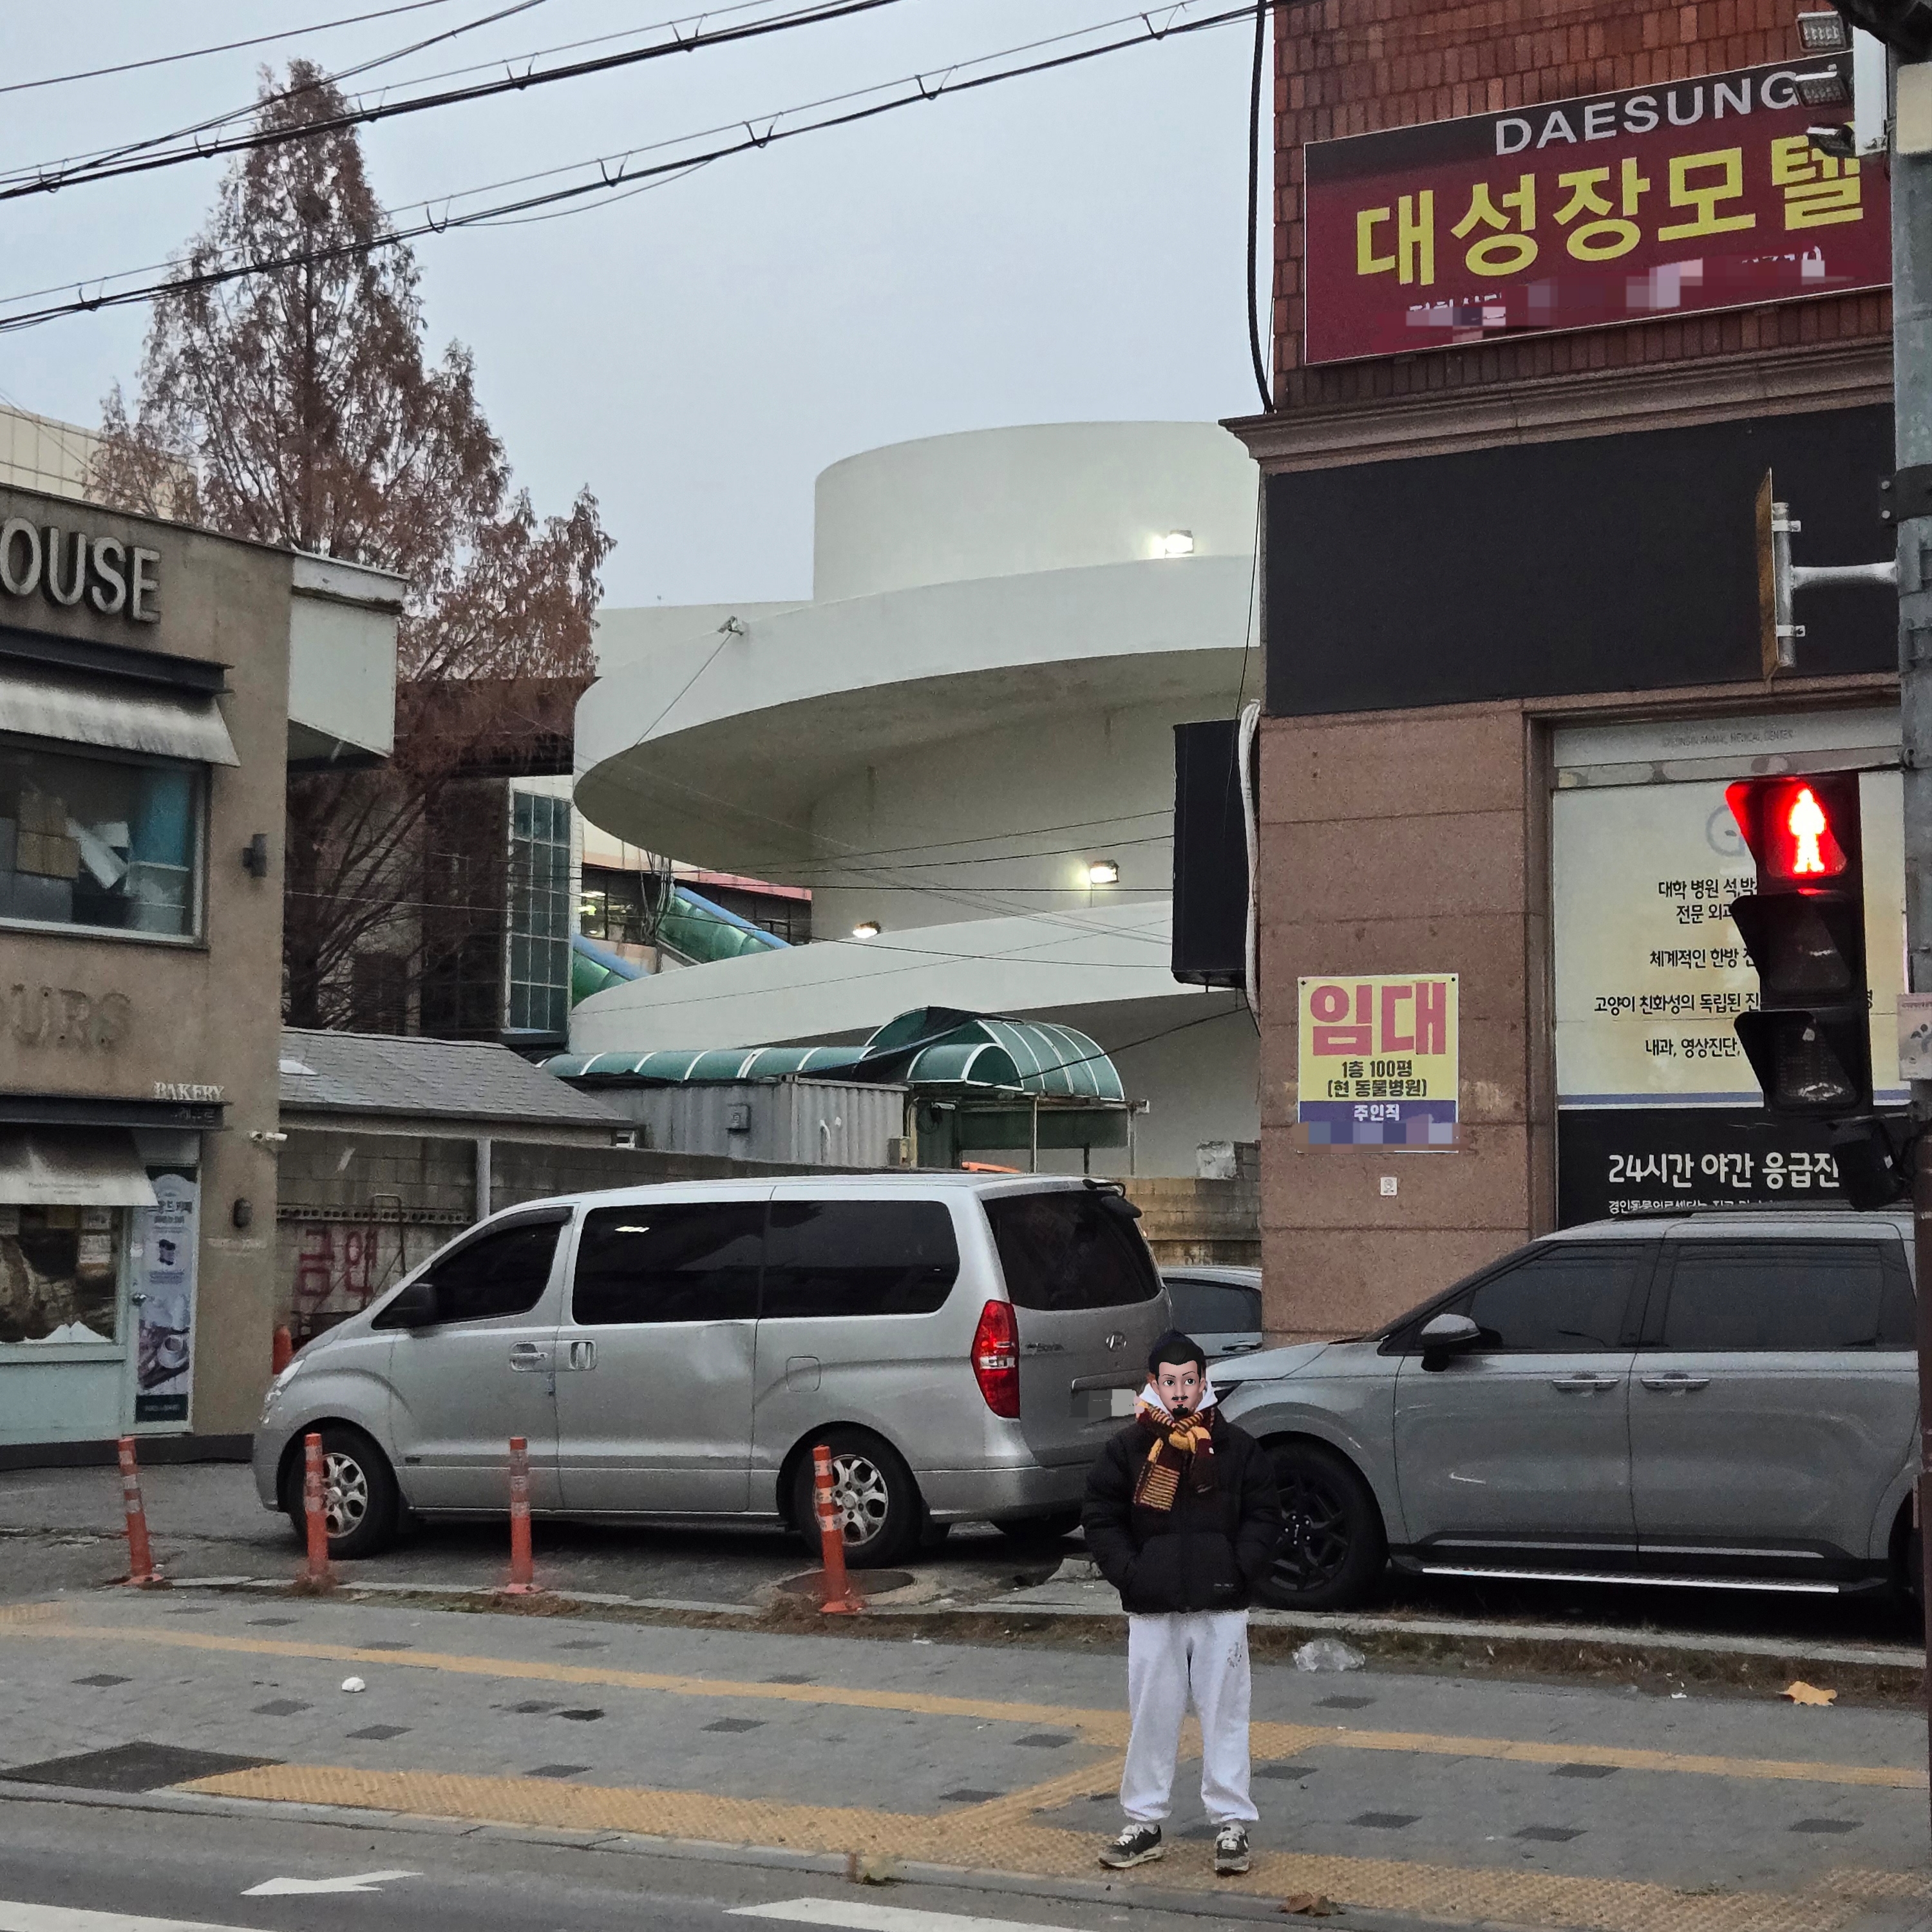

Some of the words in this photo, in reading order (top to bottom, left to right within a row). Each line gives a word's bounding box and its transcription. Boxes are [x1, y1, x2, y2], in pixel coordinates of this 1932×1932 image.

[1495, 71, 1799, 156] DAESUNG
[1356, 121, 1864, 286] 대성장모텔
[1658, 880, 1687, 900] 대학
[1690, 879, 1719, 900] 병원
[1676, 905, 1704, 924] 전문
[1650, 949, 1706, 969] 체계적인
[1710, 948, 1739, 968] 한방
[1594, 996, 1635, 1016] 고양이
[1640, 994, 1694, 1014] 친화성의
[1700, 993, 1741, 1013] 독립된
[1310, 982, 1446, 1056] 임대
[1645, 1039, 1677, 1057] 내과,
[1342, 1061, 1364, 1078] 1층
[1370, 1060, 1412, 1077] 100평
[153, 1082, 225, 1101] BAKERY
[1609, 1153, 1695, 1188] 24시간
[1701, 1153, 1755, 1188] 야간
